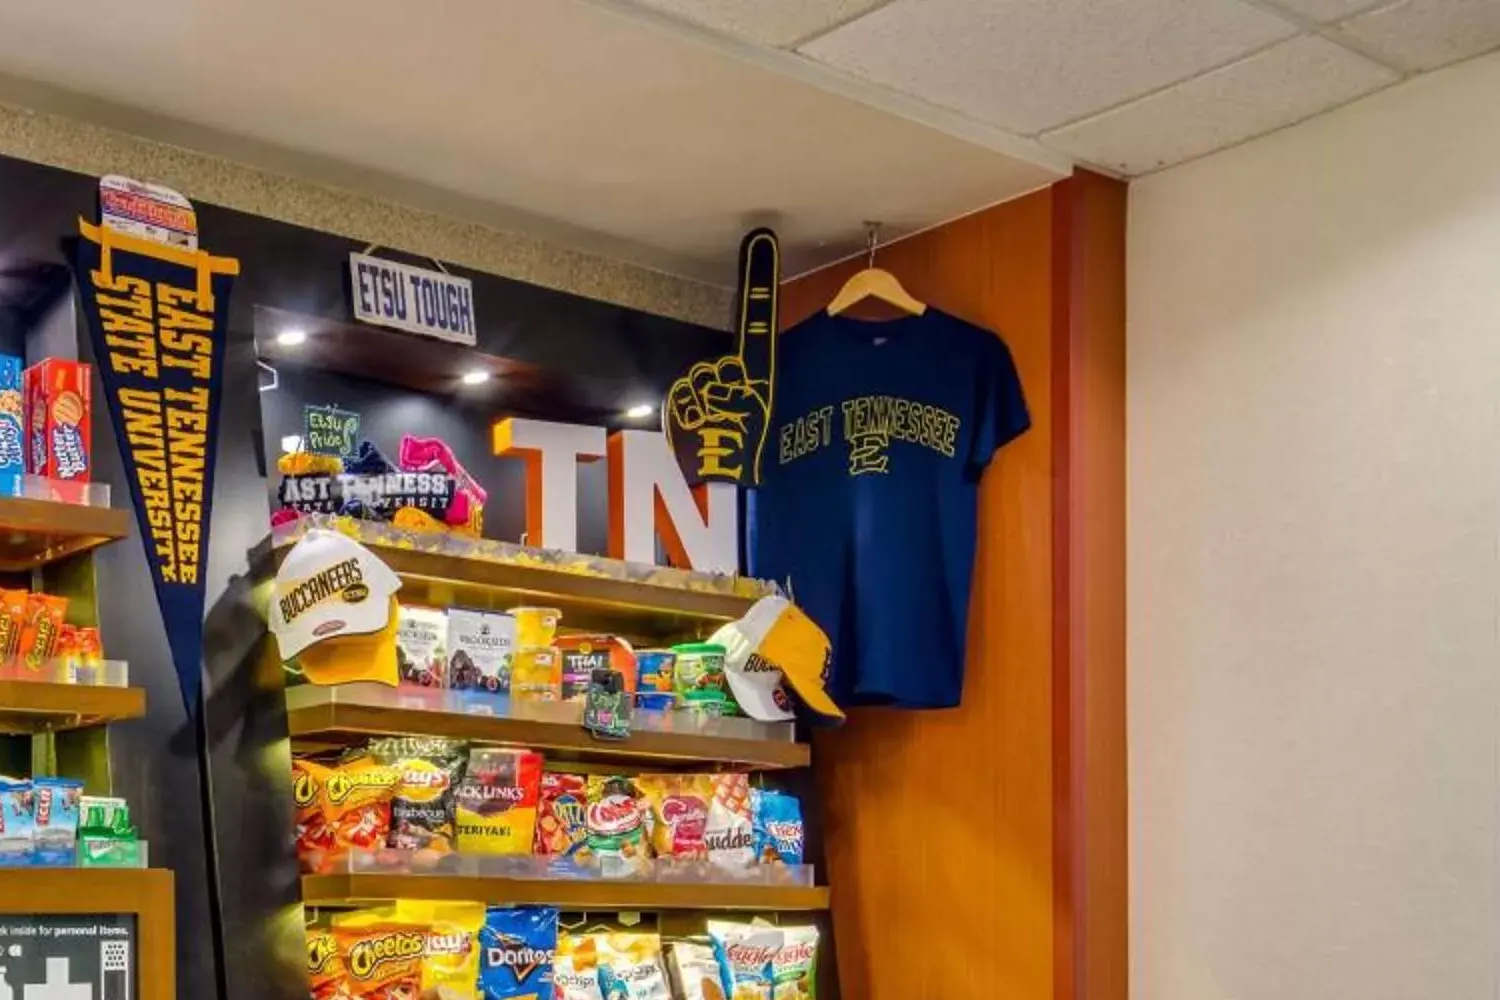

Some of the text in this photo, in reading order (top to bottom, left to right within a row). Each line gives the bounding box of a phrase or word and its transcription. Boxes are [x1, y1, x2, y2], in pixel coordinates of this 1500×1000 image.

[94, 273, 160, 380] STATE
[356, 262, 474, 337] ETSU TOUGH
[156, 281, 216, 585] EAST TENNESSEE
[779, 395, 962, 466] EAST TENNESSEE
[116, 385, 179, 584] UNIVERSITY
[284, 476, 332, 501] AST
[494, 417, 739, 578] TN
[278, 557, 364, 624] BUCCANEERS
[567, 655, 603, 669] THAI
[454, 787, 525, 799] ACK LINK'S
[457, 824, 512, 837] TERIYAKI
[9, 926, 37, 937] inside
[39, 925, 54, 936] for
[53, 925, 97, 939] personal
[350, 931, 423, 981] Cheetos
[487, 946, 556, 967] Doritos
